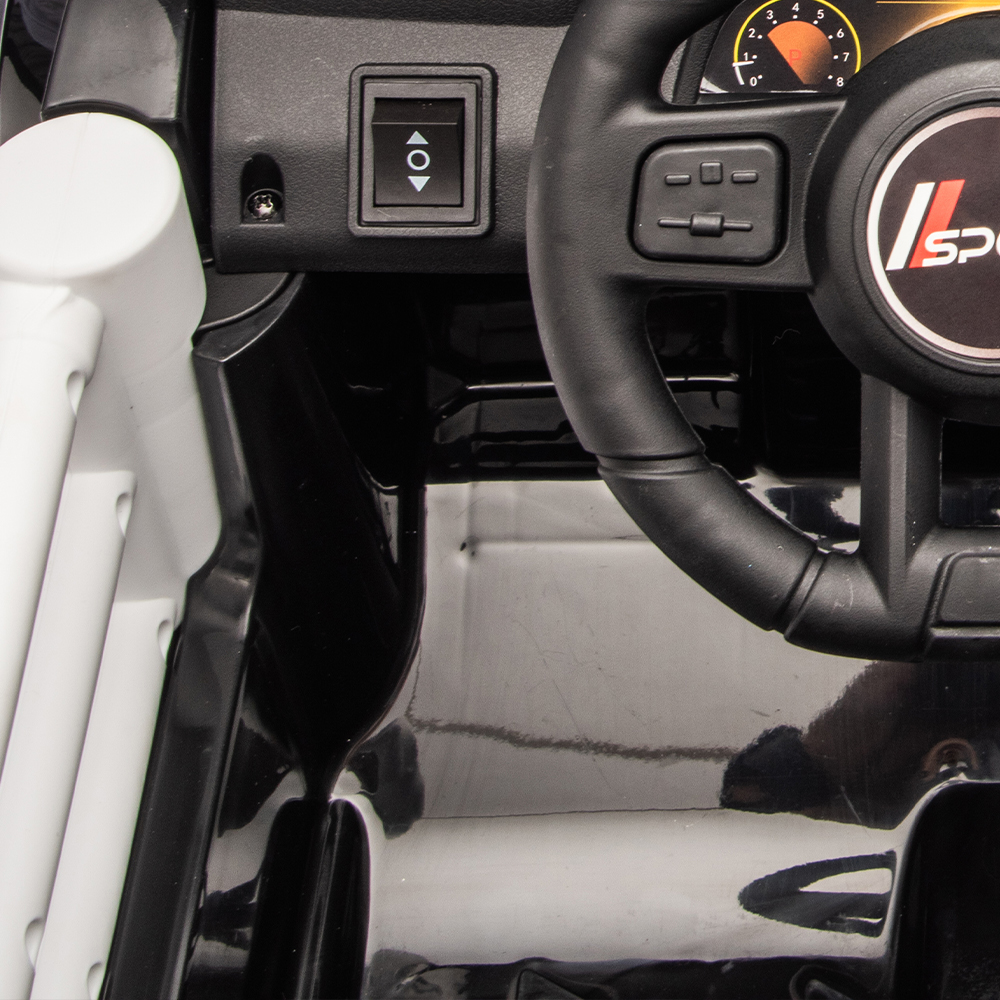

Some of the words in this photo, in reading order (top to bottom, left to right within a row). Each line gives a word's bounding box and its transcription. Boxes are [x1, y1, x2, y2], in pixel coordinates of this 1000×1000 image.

[792, 2, 799, 12] 4
[766, 9, 774, 20] 3
[817, 10, 824, 19] 5
[748, 28, 756, 38] 2
[836, 28, 845, 38] 6
[743, 52, 749, 62] 1
[842, 52, 850, 62] 7
[750, 76, 758, 87] 0
[836, 77, 845, 88] 8
